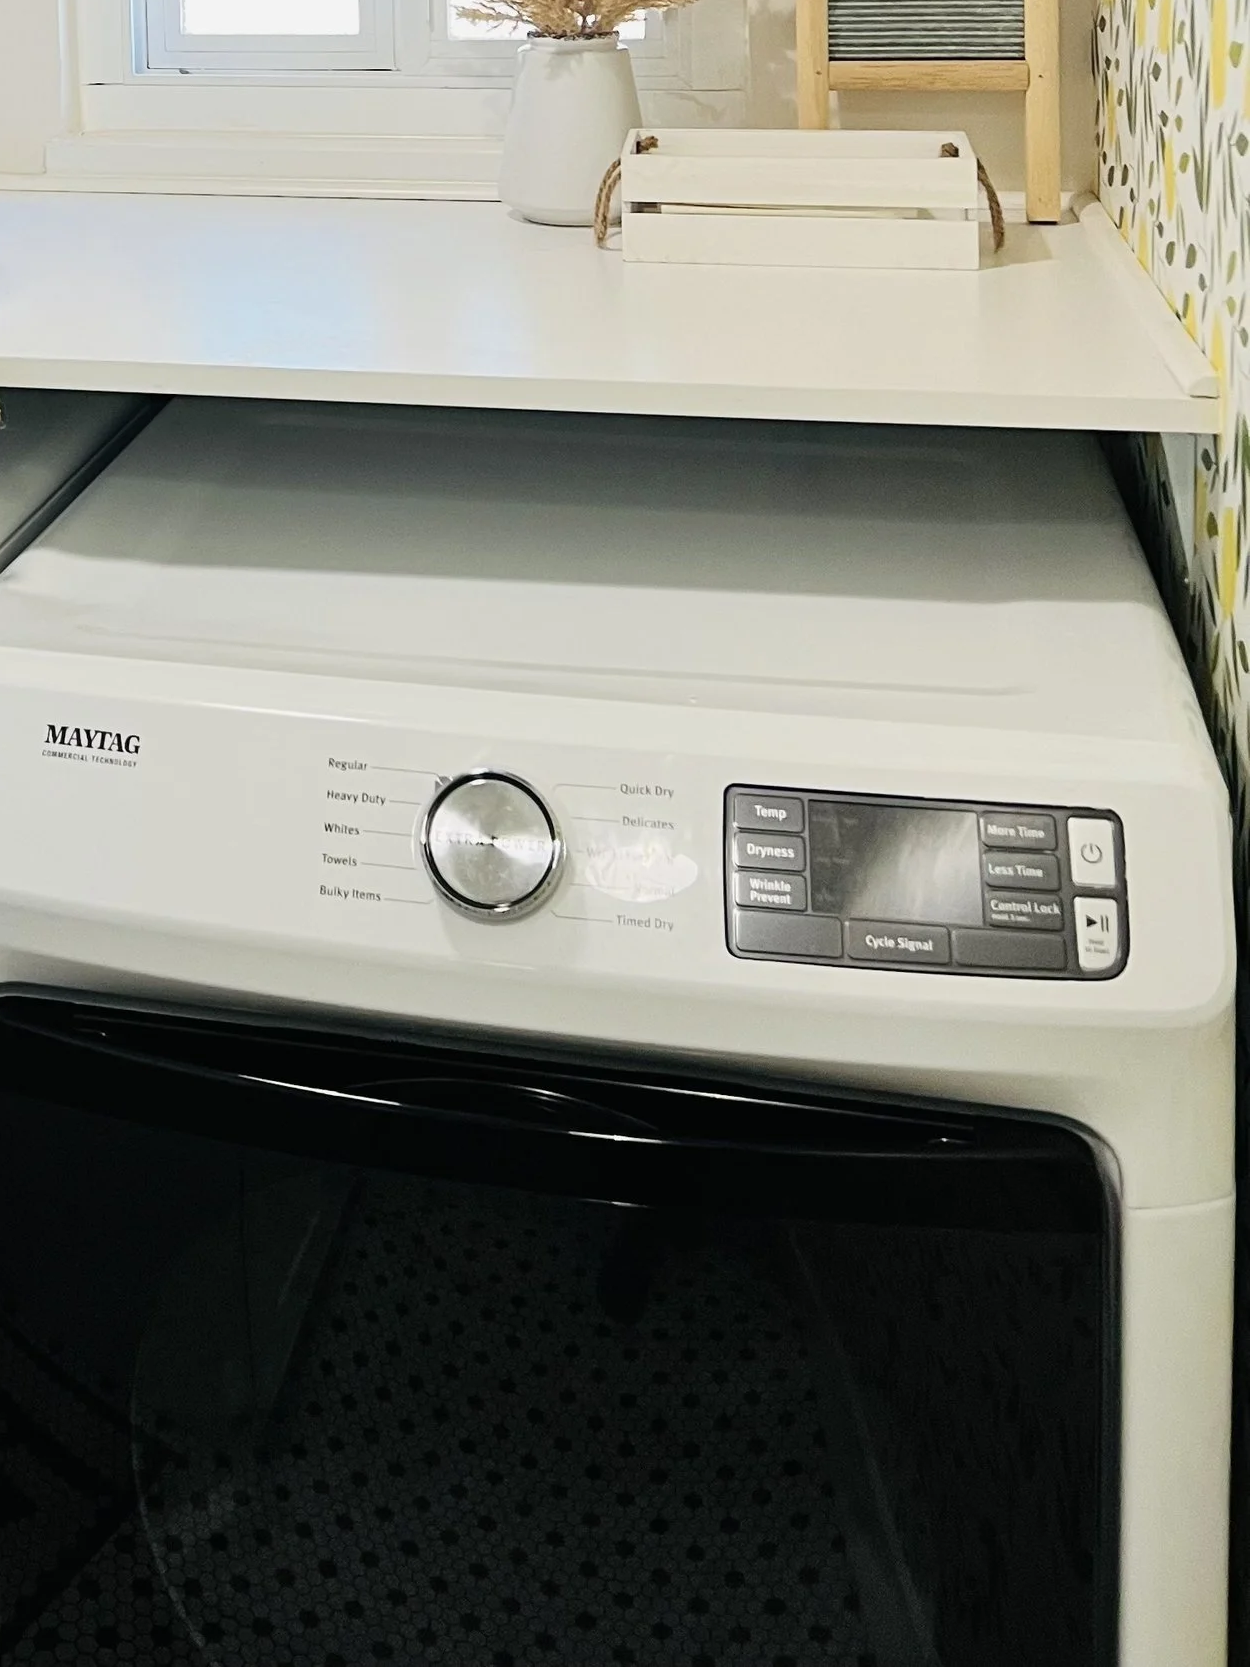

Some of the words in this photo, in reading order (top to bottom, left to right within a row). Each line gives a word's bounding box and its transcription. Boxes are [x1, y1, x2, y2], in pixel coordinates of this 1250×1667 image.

[44, 723, 141, 755] MAYTAG
[41, 749, 88, 762] COMMERCIAL
[91, 755, 138, 768] TECHNOLOGY
[328, 757, 368, 771] Regular
[326, 789, 359, 804] Heavy
[361, 792, 386, 806] Duty
[620, 783, 651, 796] Quick
[654, 785, 674, 799] Dry
[754, 804, 787, 822] Temp
[324, 821, 360, 835] Whites
[622, 815, 675, 830] Delicates
[987, 824, 1015, 837] More
[1016, 825, 1046, 839] Time
[746, 842, 795, 858] Dryness
[321, 853, 358, 867] Towels
[988, 863, 1014, 876] Less
[1014, 864, 1044, 878] Time
[750, 877, 792, 892] Wrinkle
[319, 885, 350, 900] Bulky
[352, 888, 382, 902] Items
[750, 890, 792, 905] Prevent
[990, 899, 1032, 913] Control
[1033, 901, 1061, 915] Lock
[617, 915, 651, 929] Timed
[654, 917, 674, 932] Dry
[865, 934, 896, 950] Cycle
[897, 937, 933, 952] Signal
